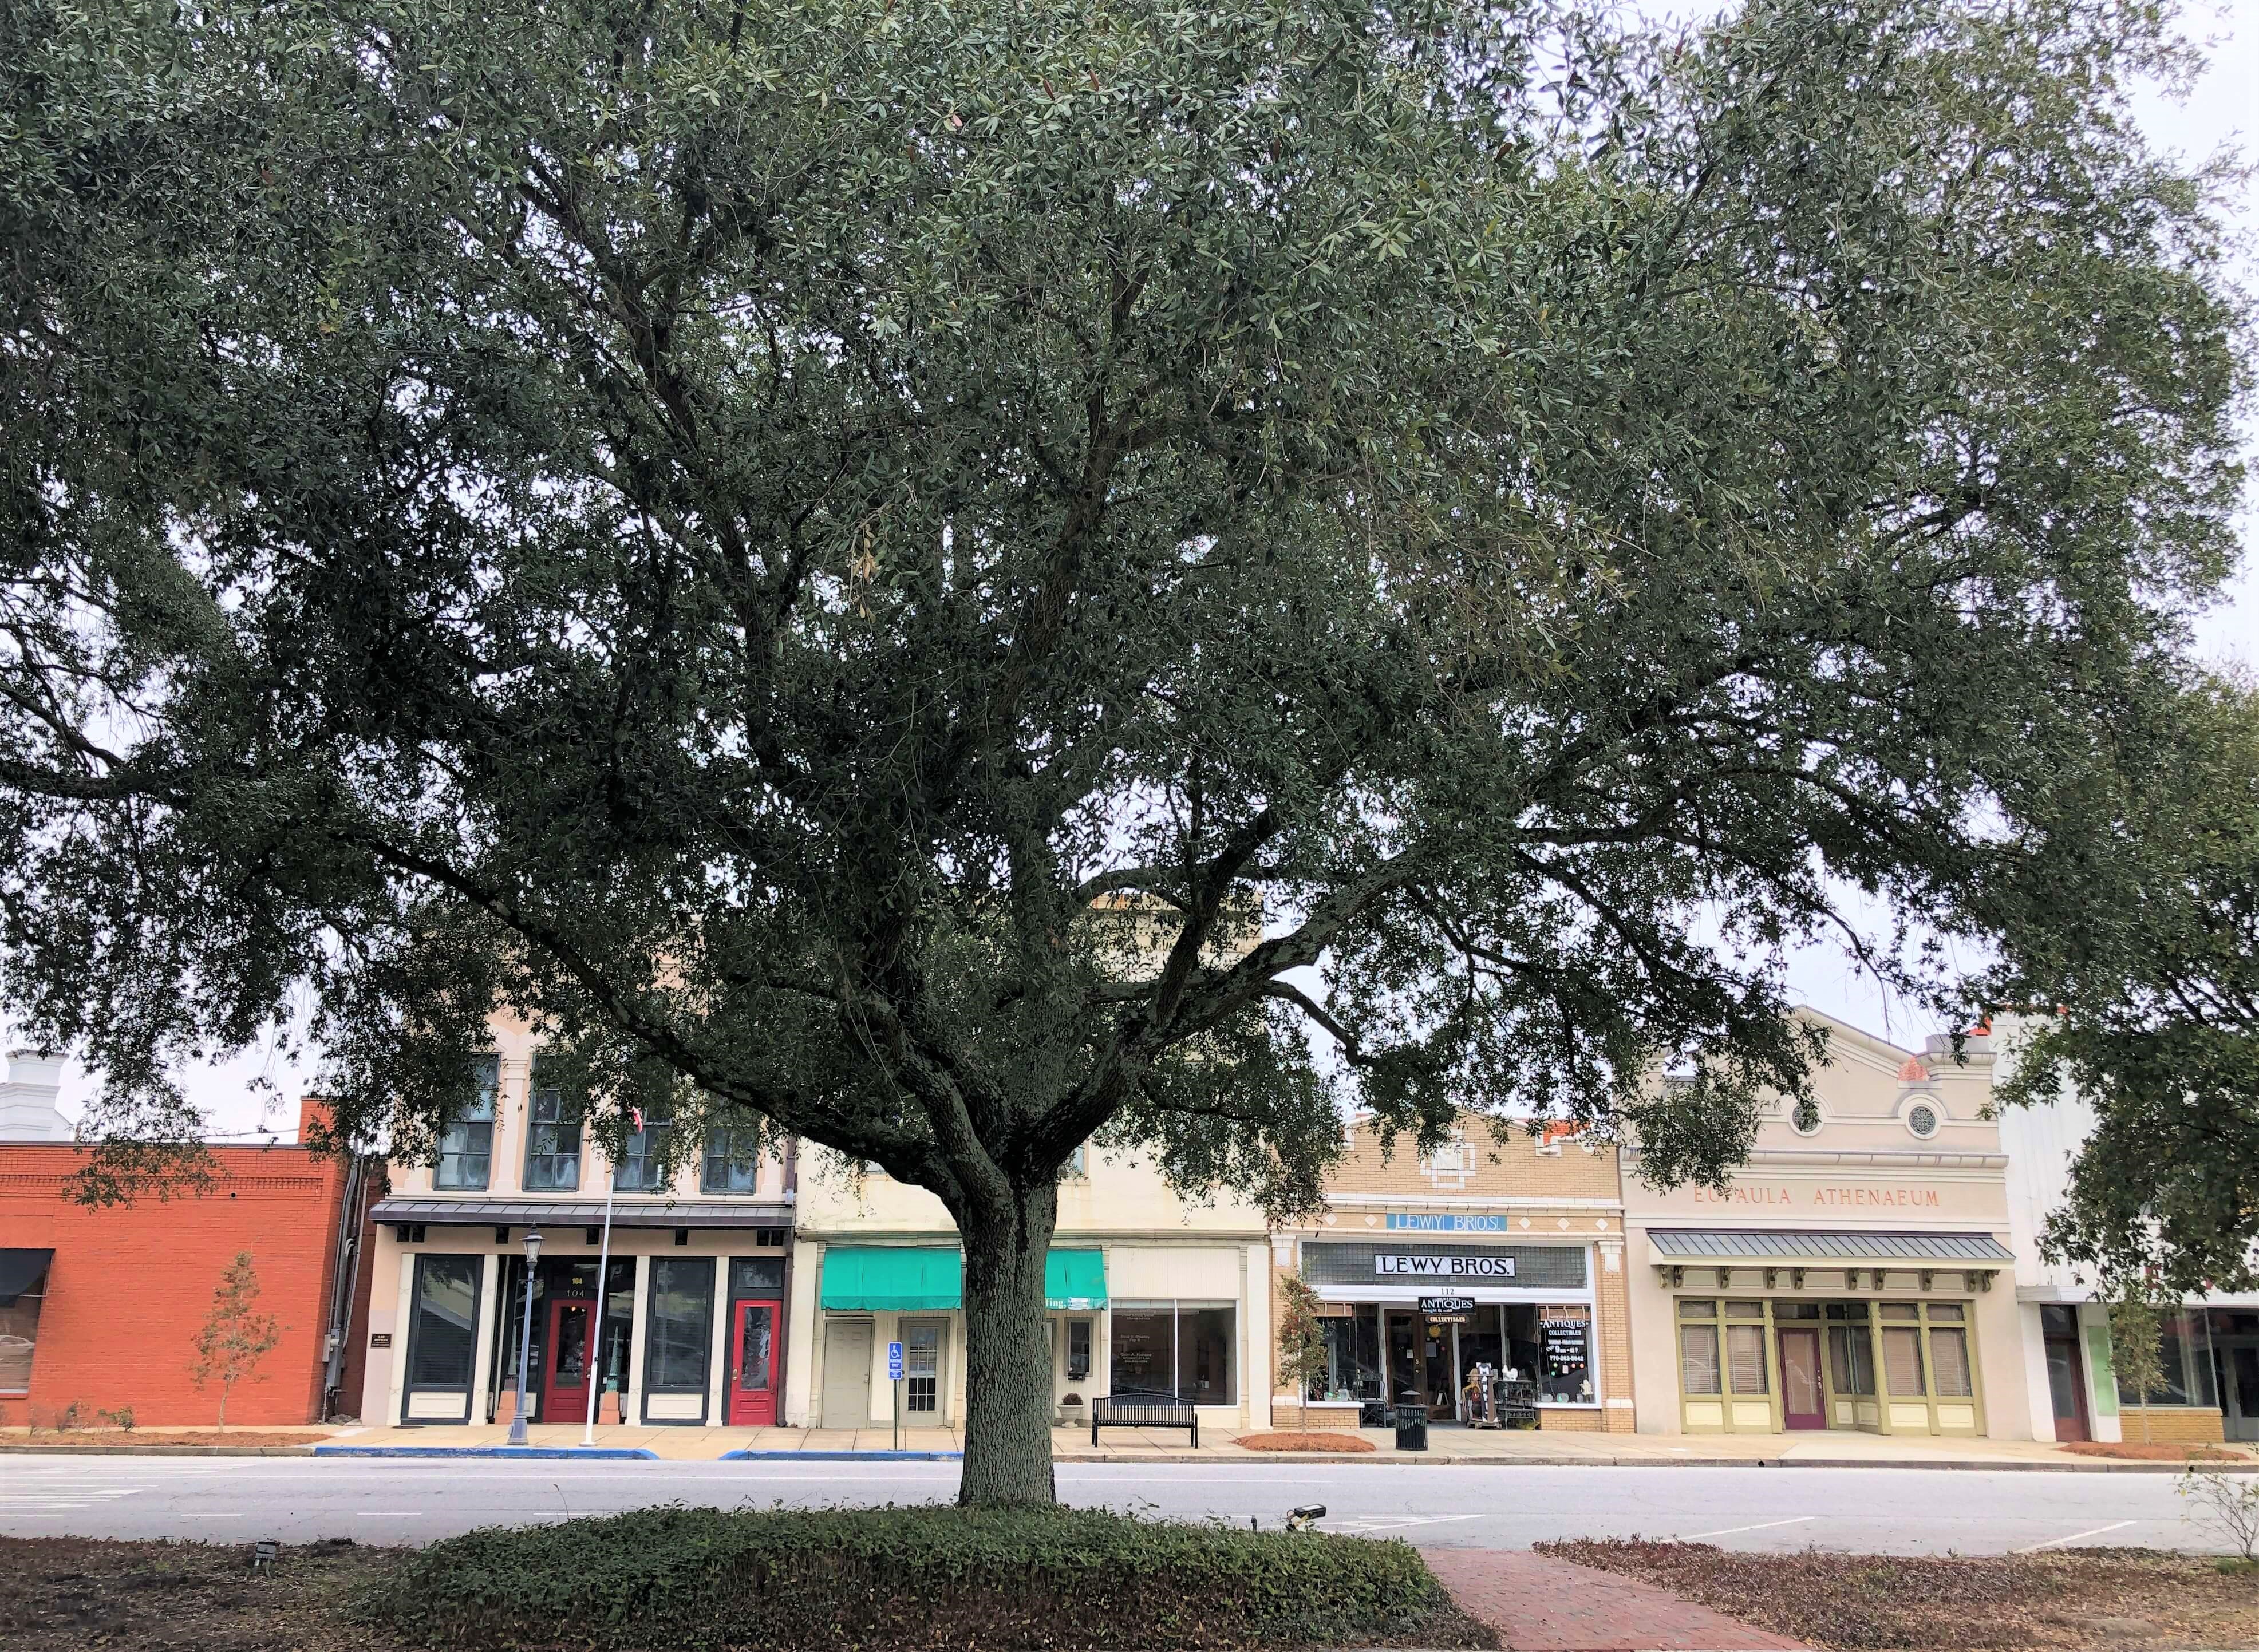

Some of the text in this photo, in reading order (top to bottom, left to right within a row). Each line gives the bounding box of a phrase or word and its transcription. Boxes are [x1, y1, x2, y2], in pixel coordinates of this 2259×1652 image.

[1693, 1187, 1940, 1206] EUAULA ATHENAEUM
[1397, 1214, 1501, 1231] LEWY BROS.
[1382, 1256, 1510, 1275] LEWY BROS.
[1421, 1299, 1473, 1310] ANTIQUES
[1542, 1319, 1586, 1329] ANTIQUES
